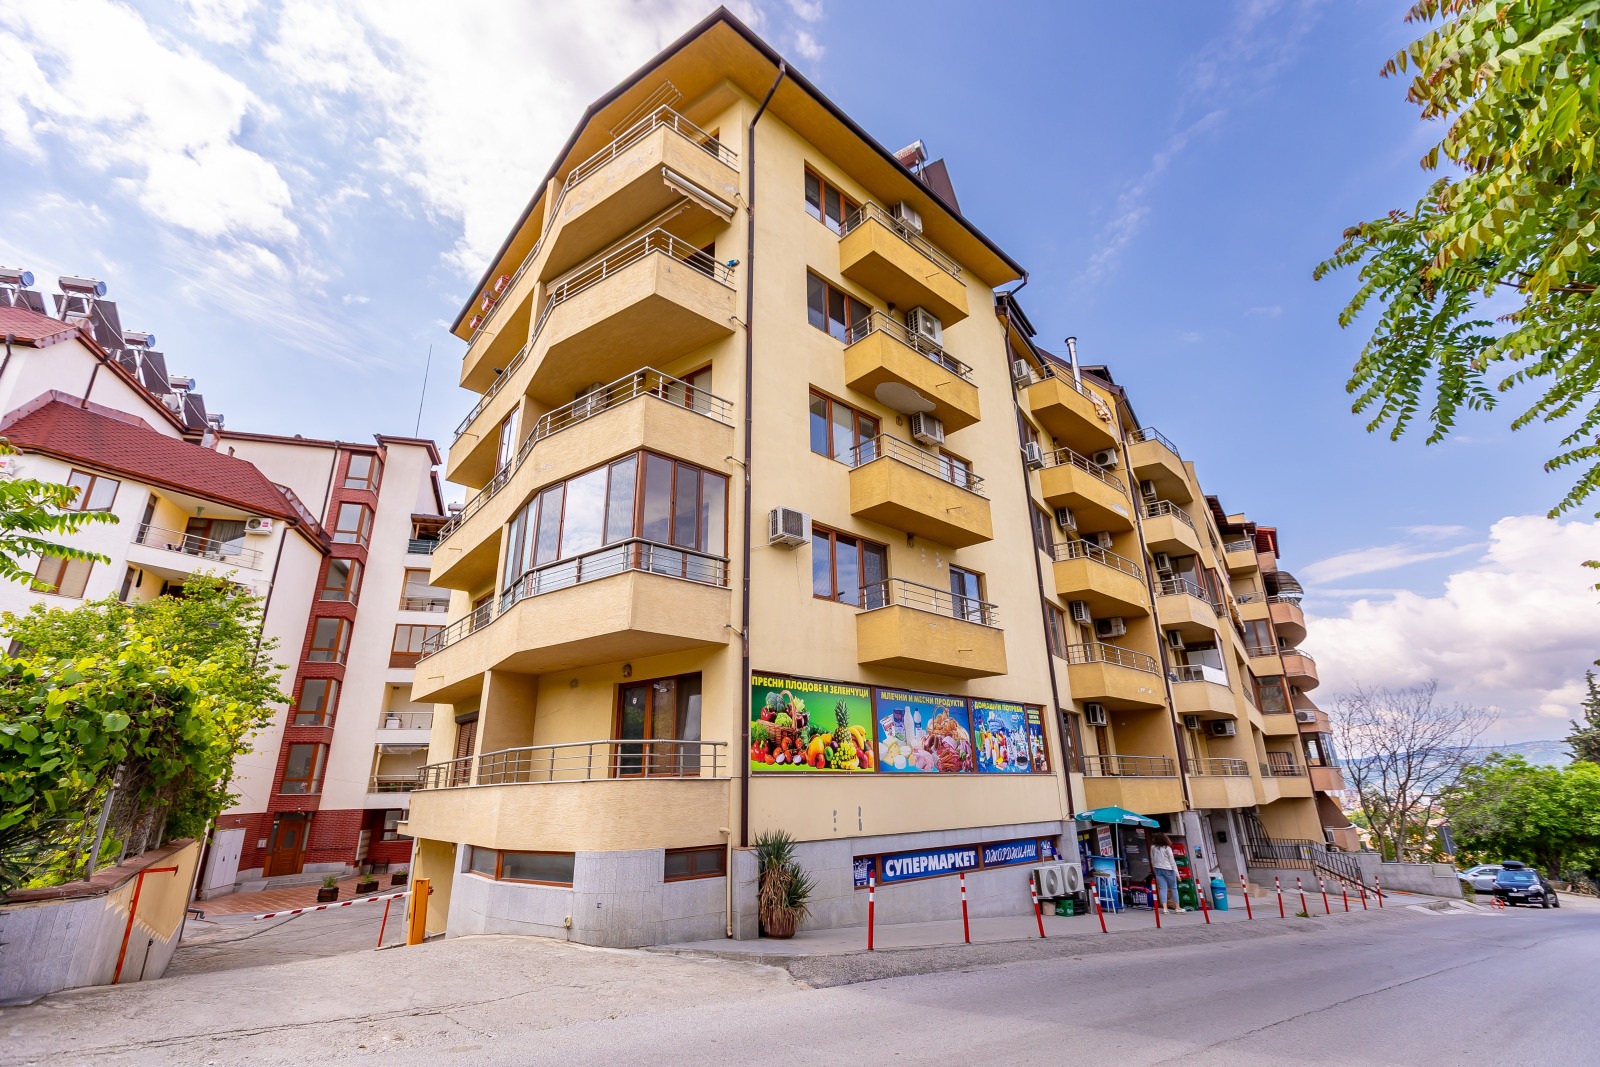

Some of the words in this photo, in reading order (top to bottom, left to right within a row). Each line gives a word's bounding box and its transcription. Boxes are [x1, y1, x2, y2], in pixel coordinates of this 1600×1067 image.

[751, 676, 784, 688] ПРЕСНИ
[785, 680, 822, 693] ПЛОДОВЕ
[823, 683, 829, 694] И
[829, 685, 869, 698] ЗЕЛЕНЧУЦИ
[881, 691, 908, 702] МЛЕЧНИ
[914, 695, 934, 705] МЕСНИ
[934, 697, 964, 708] ПРОДУКТИ
[885, 851, 976, 877] СУПЕРМАРКЕТ
